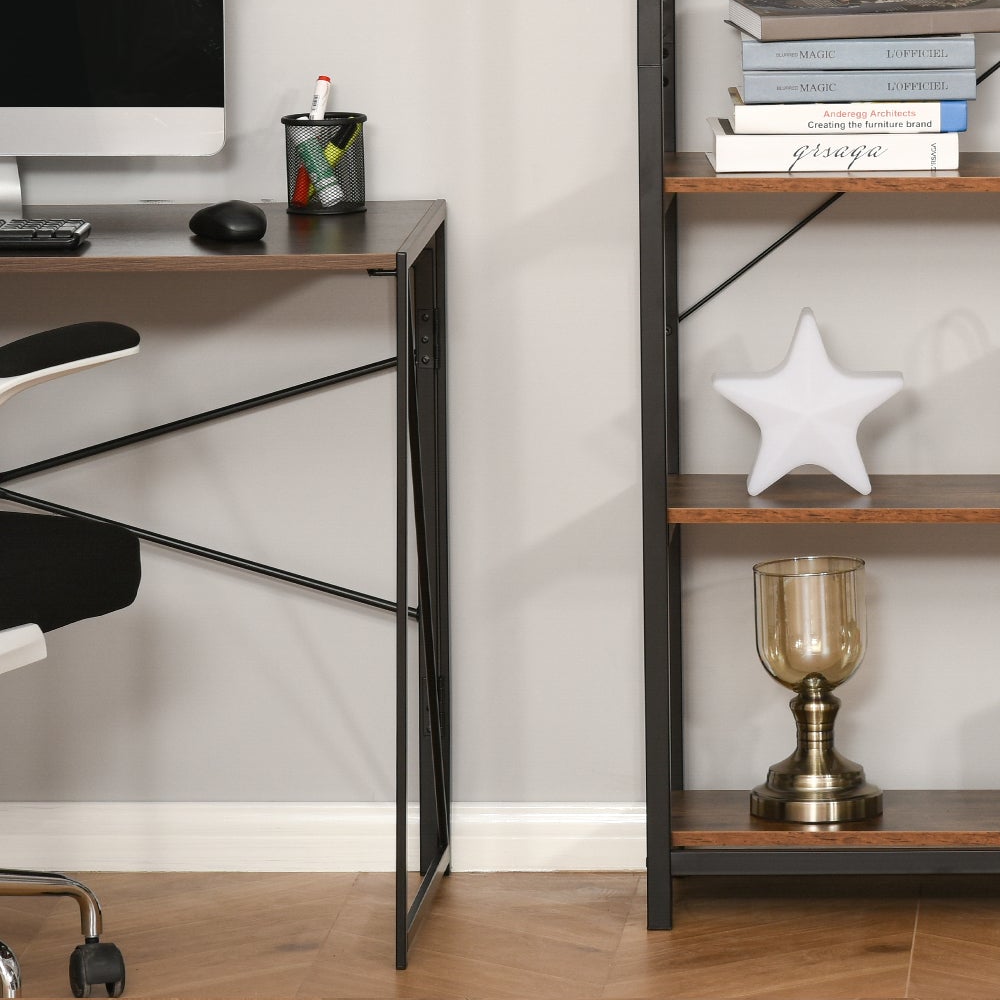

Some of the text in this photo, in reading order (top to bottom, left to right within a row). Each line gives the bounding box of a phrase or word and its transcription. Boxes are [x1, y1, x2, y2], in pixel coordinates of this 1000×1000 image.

[800, 50, 836, 60] MAGIC
[886, 49, 948, 59] L'OFFICIEL
[800, 83, 837, 92] MAGIC
[887, 82, 948, 92] L'OFFICIEL
[823, 110, 917, 119] Anderegg Architects
[807, 120, 932, 130] Creating the furniture brand
